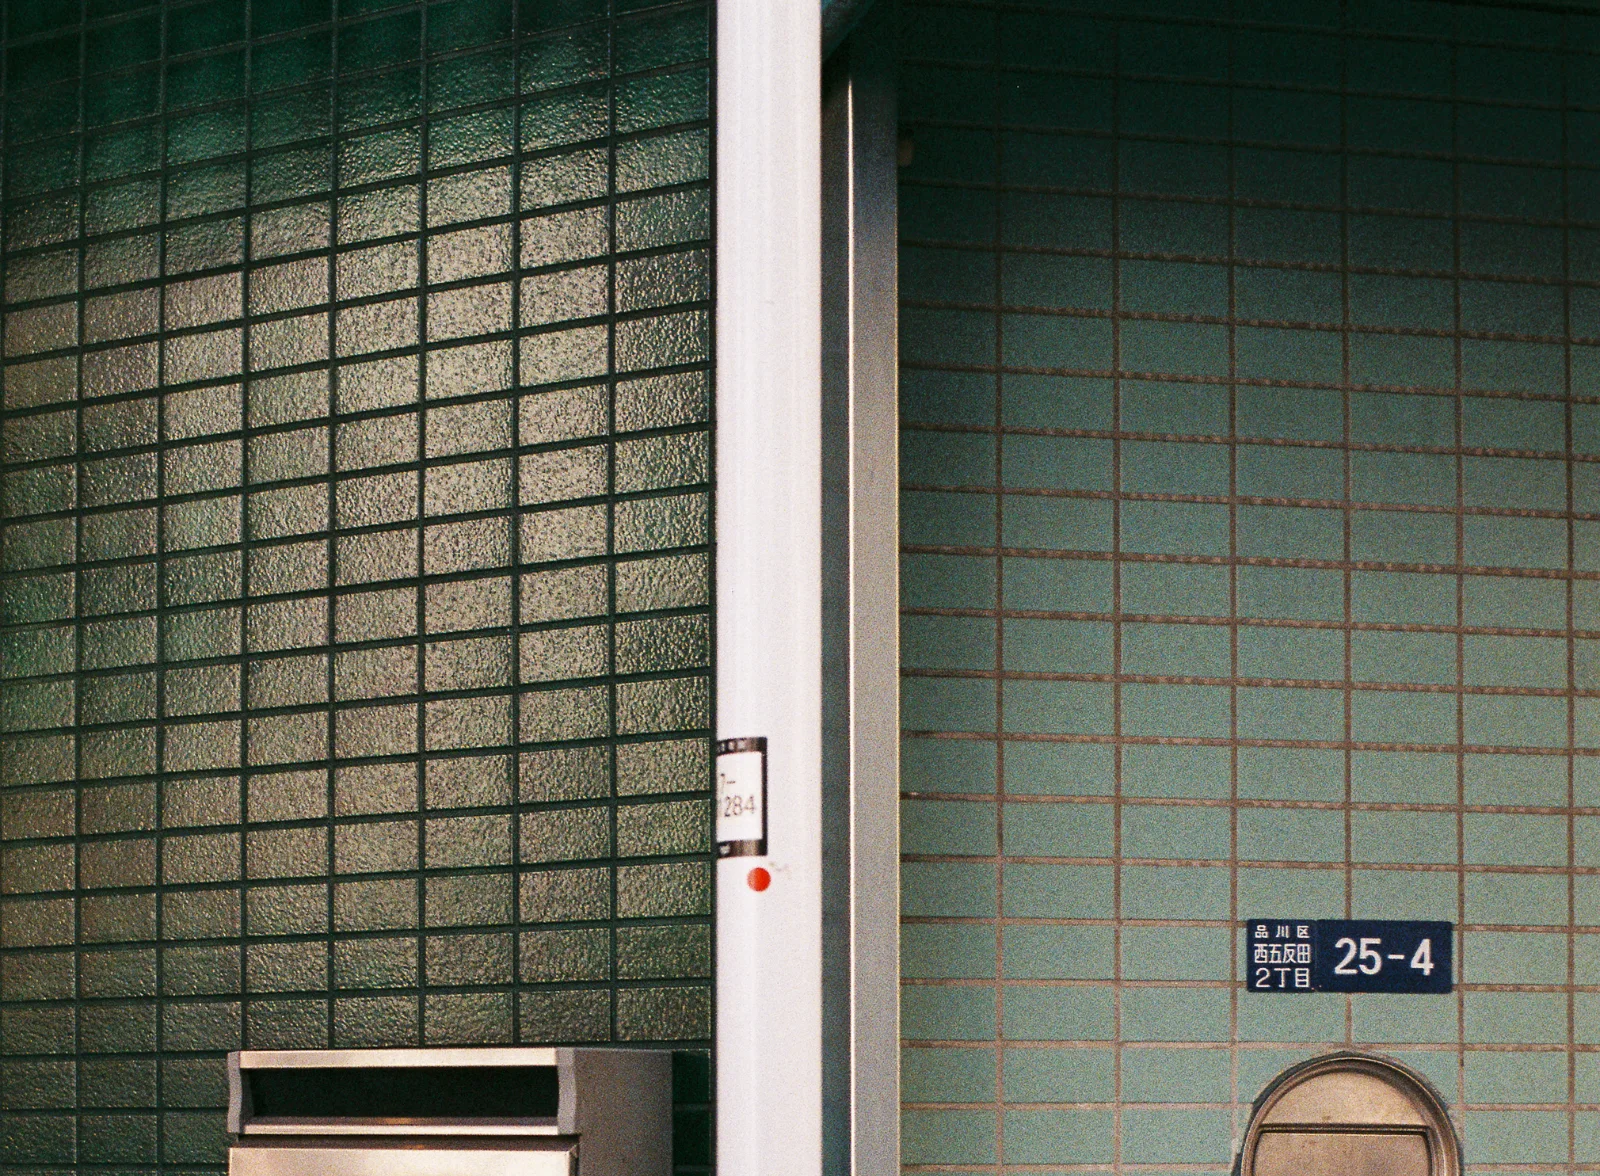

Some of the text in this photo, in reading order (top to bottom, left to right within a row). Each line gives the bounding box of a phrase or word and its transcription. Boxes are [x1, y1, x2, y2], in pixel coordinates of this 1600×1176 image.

[1254, 924, 1311, 939] 品川区
[1254, 943, 1312, 964] 西五反田
[1334, 937, 1434, 976] 25-4
